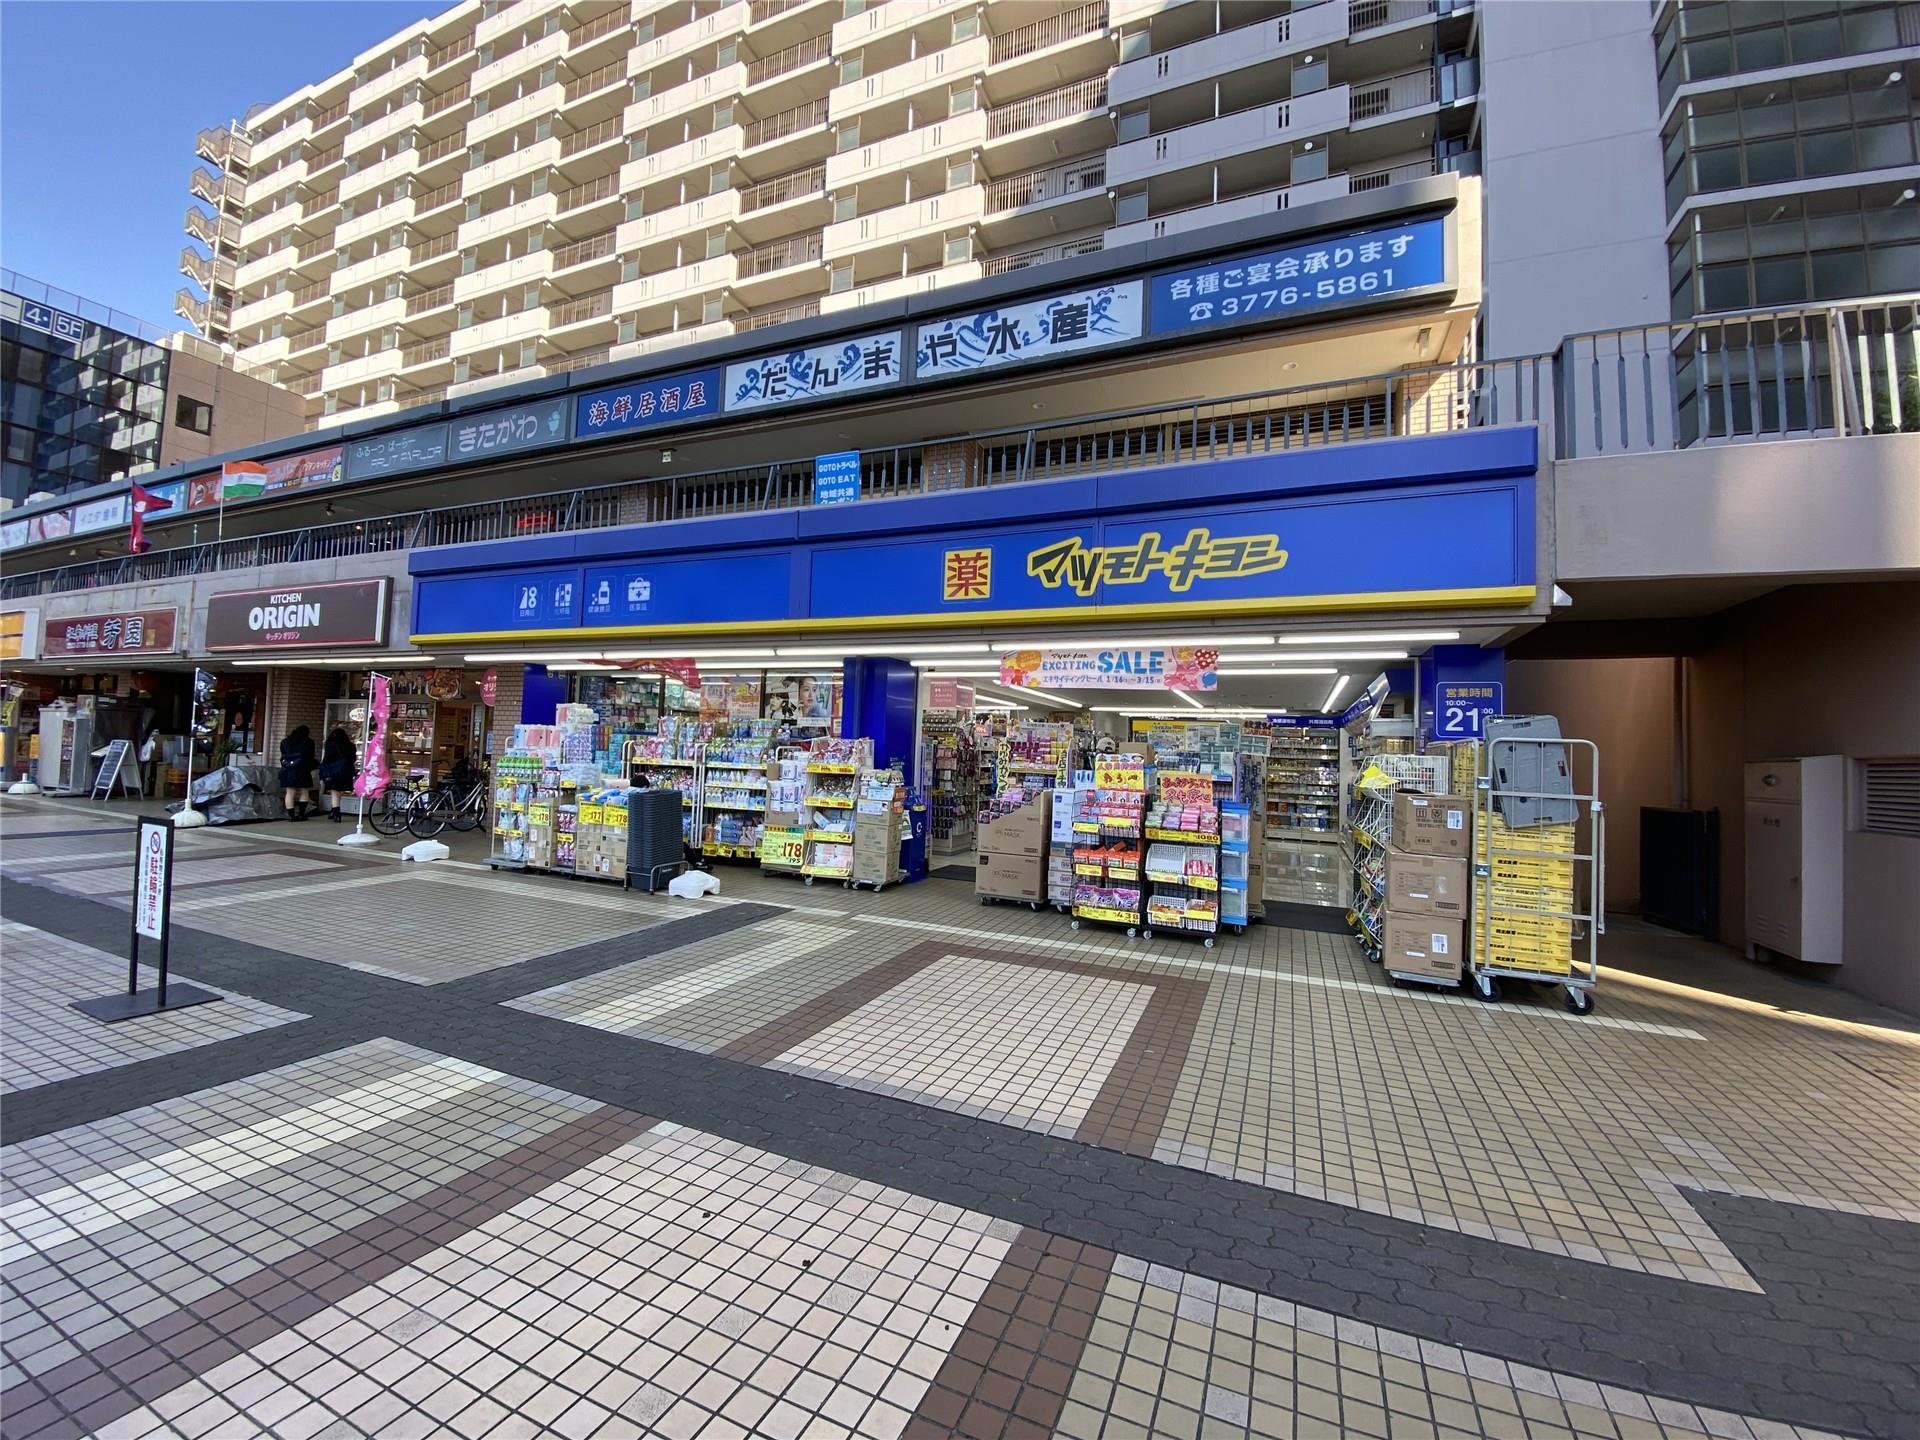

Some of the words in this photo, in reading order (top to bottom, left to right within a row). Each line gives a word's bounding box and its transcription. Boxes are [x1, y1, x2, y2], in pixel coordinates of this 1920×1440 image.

[1170, 234, 1415, 301] 各種ご宴会承ります
[1221, 268, 1393, 317] 3776-5861
[760, 345, 893, 399] だんま
[925, 302, 1089, 367] や水産
[588, 380, 707, 427] 海鮮居酒屋
[458, 413, 539, 453] きたがわ
[837, 473, 856, 484] EAT
[945, 550, 990, 598] 薬
[1029, 529, 1287, 595] マツモトキヨシ
[270, 592, 302, 605] KITCHEN
[248, 602, 321, 631] ORIGIN
[1042, 660, 1095, 671] EXCITING
[1097, 650, 1165, 675] SALE
[1446, 687, 1493, 698] 営業時間
[1445, 707, 1479, 732] 21
[783, 842, 803, 857] 178
